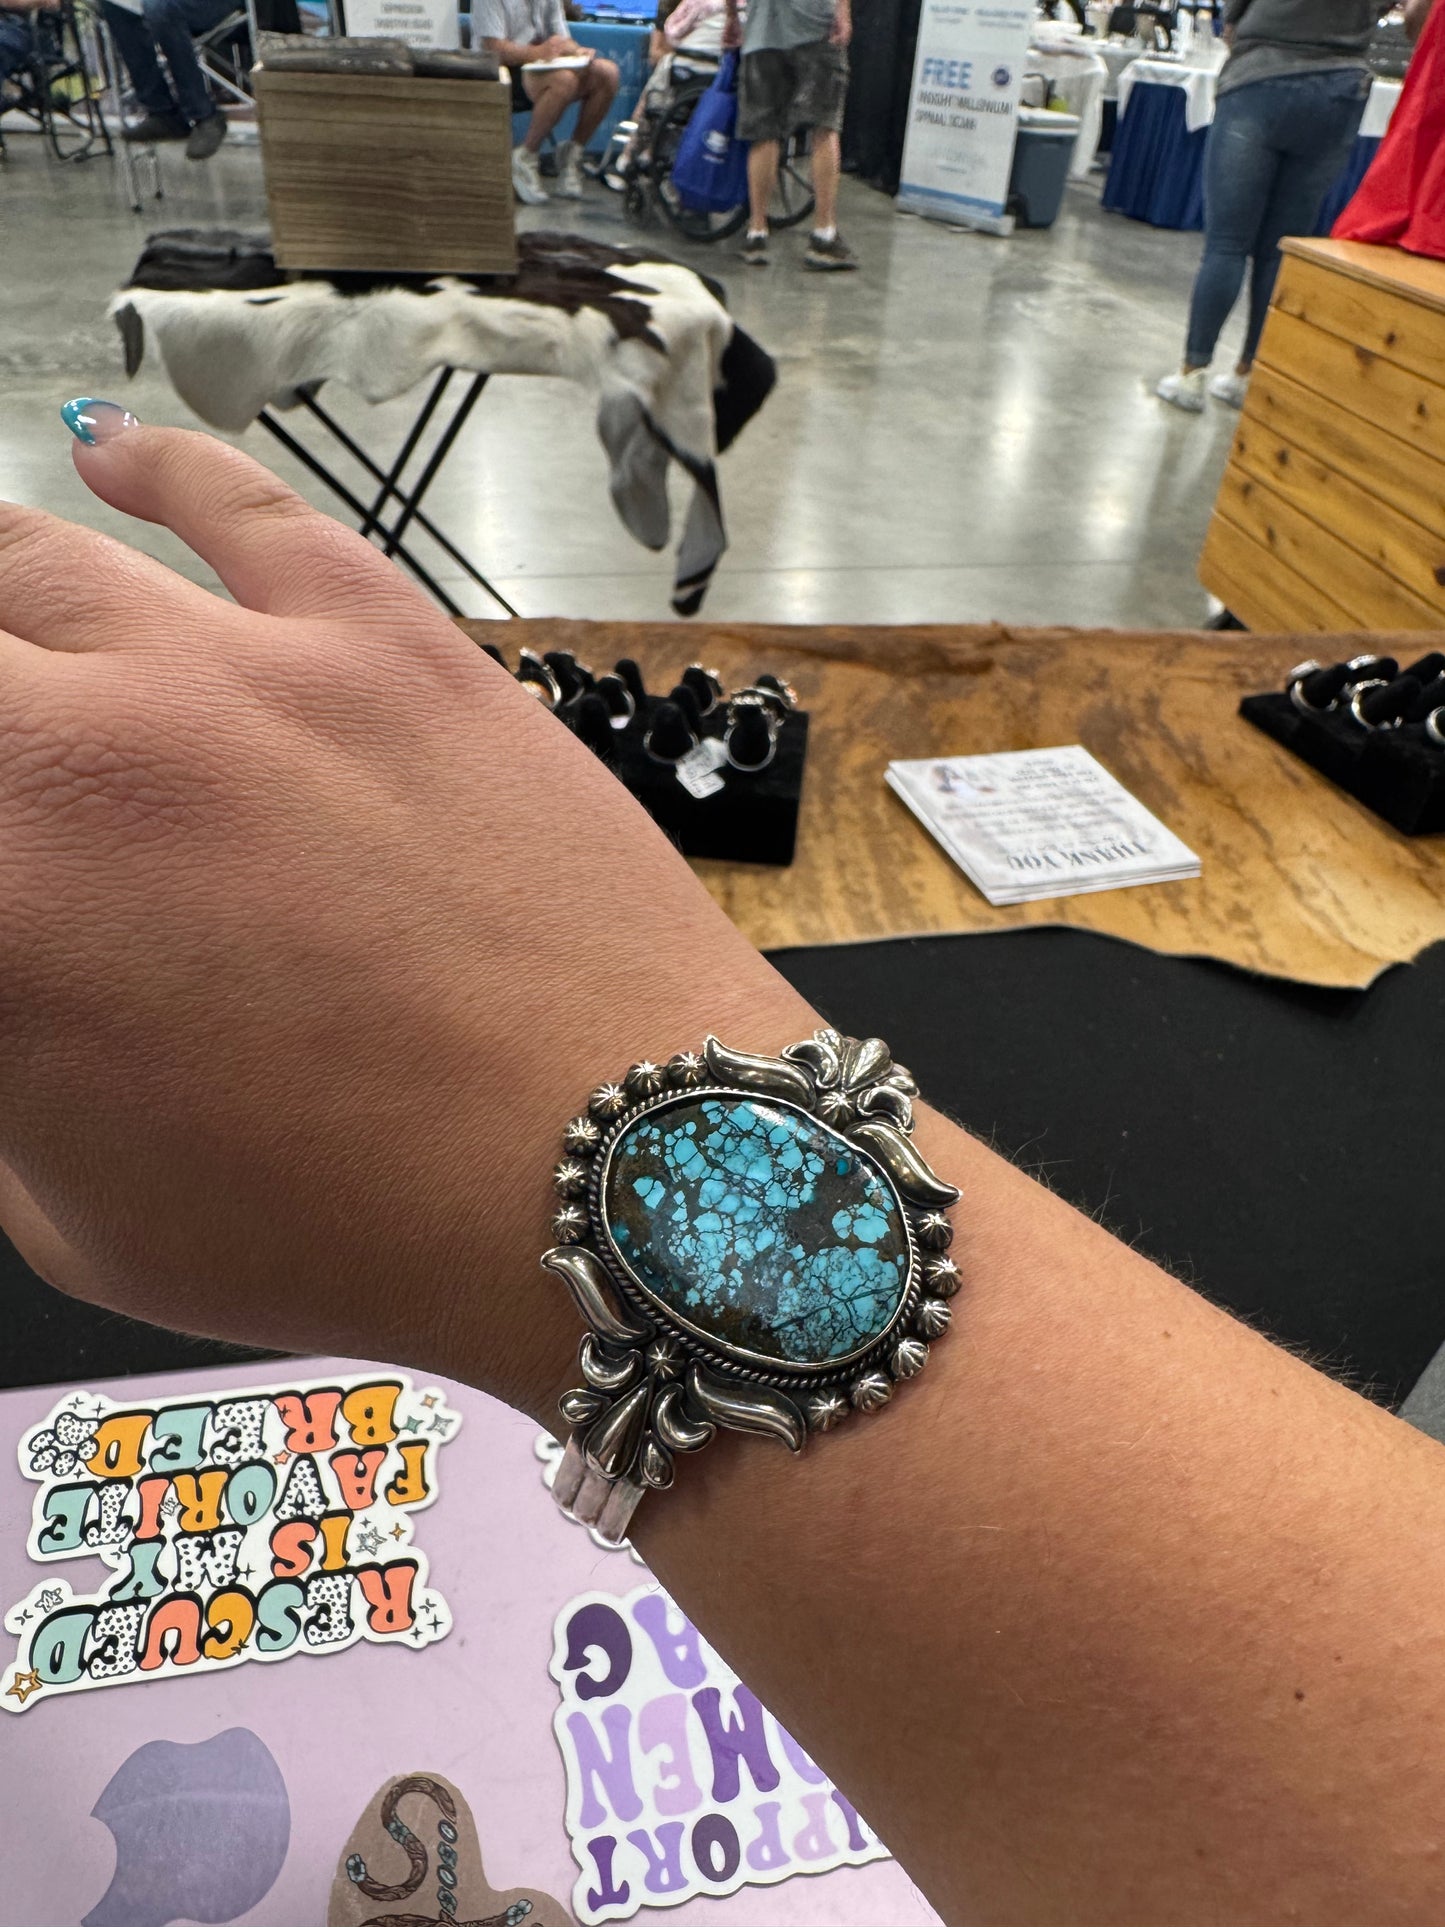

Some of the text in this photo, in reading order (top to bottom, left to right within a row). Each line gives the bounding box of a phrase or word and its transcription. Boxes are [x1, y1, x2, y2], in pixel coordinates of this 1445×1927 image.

[921, 58, 972, 90] FREE
[1006, 851, 1059, 871] YOU
[1060, 840, 1151, 867] THANK
[85, 1381, 404, 1478] BREED
[38, 1439, 430, 1554] FAVORITE
[111, 1509, 355, 1601] IS MY
[29, 1560, 419, 1684] RESCUED
